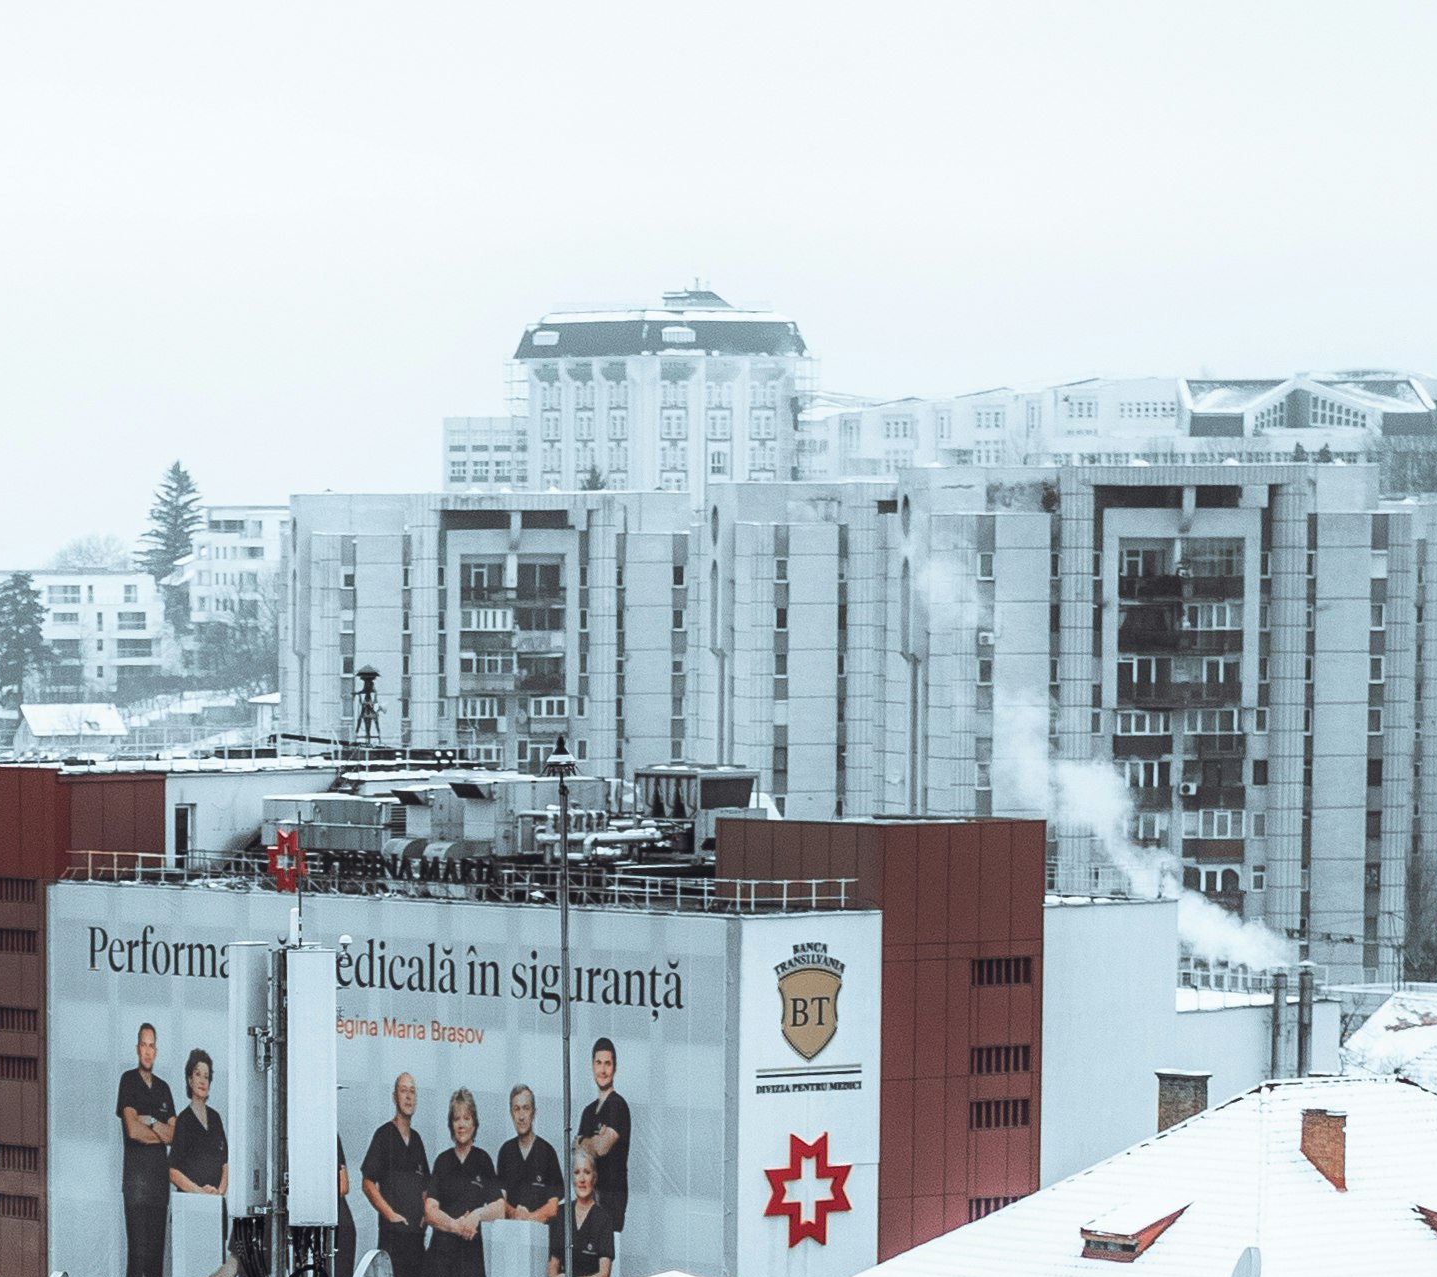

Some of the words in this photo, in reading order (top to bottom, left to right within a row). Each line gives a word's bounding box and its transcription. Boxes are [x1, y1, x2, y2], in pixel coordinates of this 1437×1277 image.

[792, 942, 828, 955] BANCA
[335, 938, 458, 995] edicală
[467, 945, 501, 998] în
[773, 954, 846, 975] TRANSILVANIA
[790, 996, 830, 1027] BT
[335, 1013, 378, 1040] egina
[382, 1016, 425, 1041] Maria
[430, 1019, 485, 1049] Brașov
[792, 1082, 828, 1093] PENTRU
[829, 1080, 863, 1091] MEDICI
